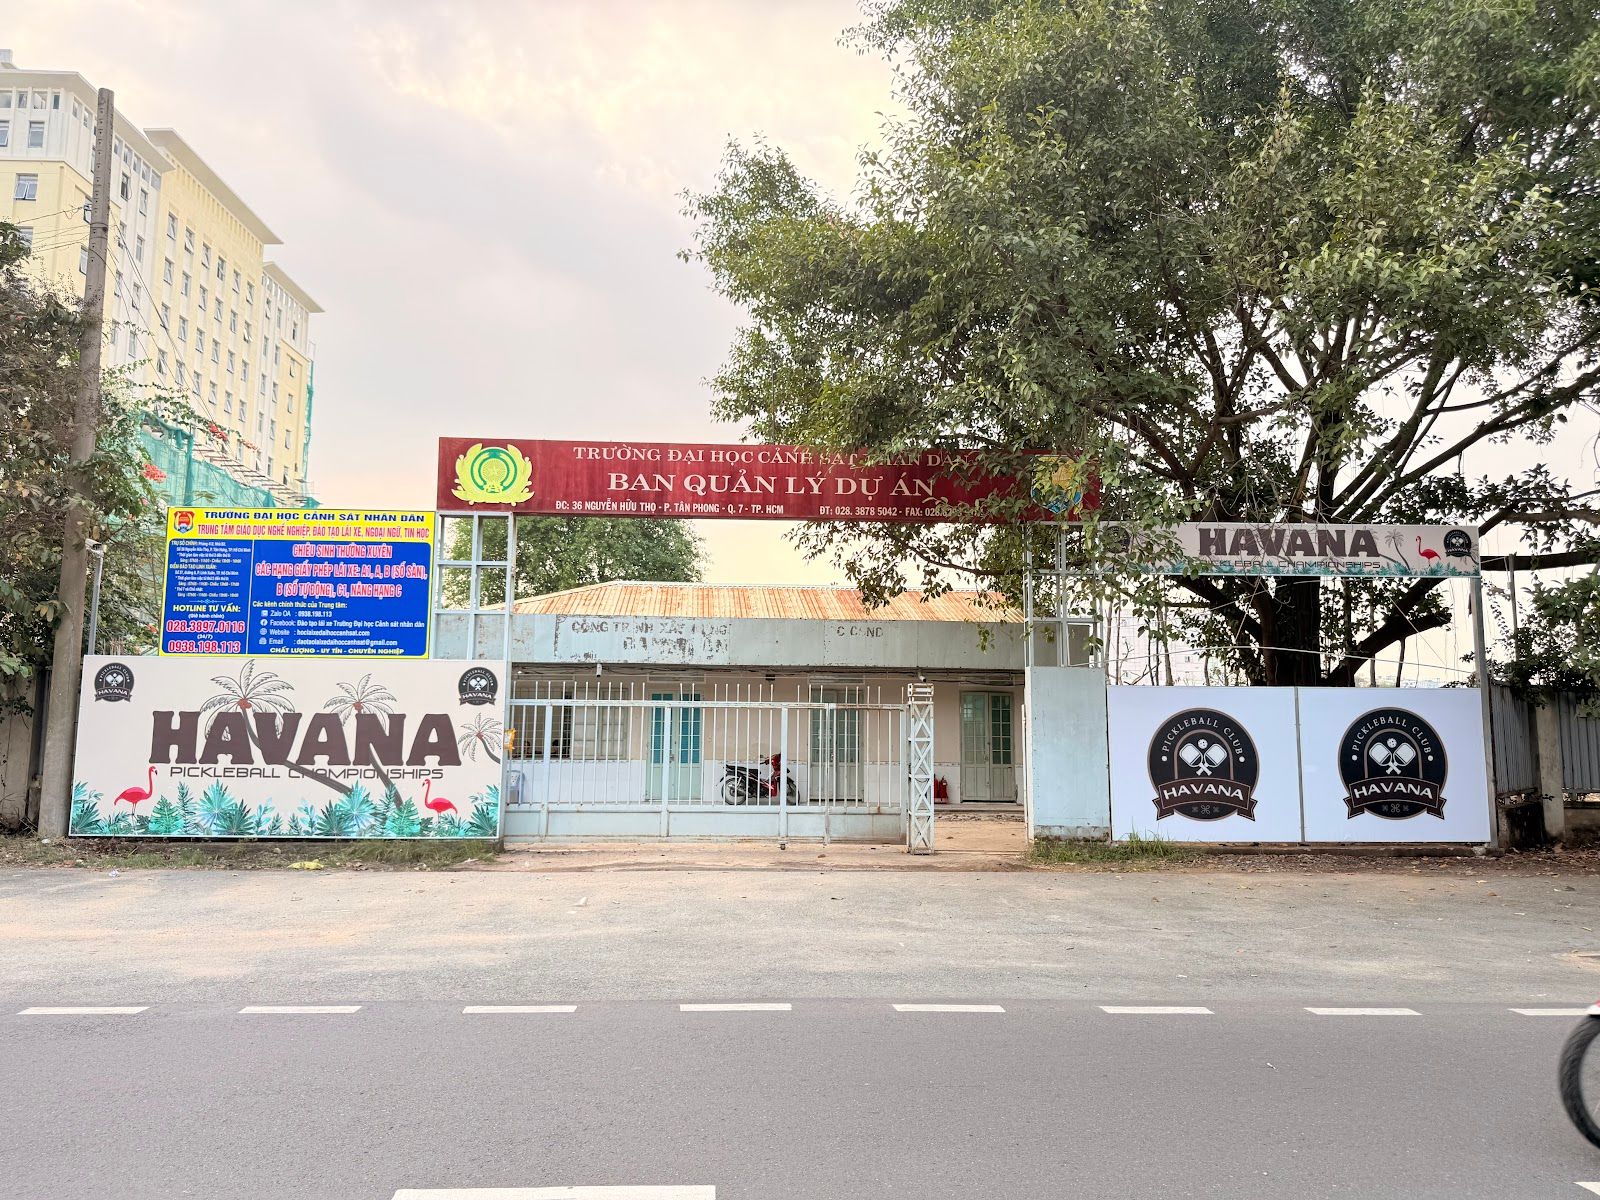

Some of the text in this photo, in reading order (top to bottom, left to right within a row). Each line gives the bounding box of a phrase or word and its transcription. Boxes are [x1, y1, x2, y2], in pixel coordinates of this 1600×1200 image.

[573, 443, 661, 461] TRƯỜNG
[667, 449, 704, 465] ĐẠI
[710, 450, 754, 466] HỌC
[757, 447, 814, 465] CẢNH
[607, 468, 934, 501] BAN QUẢN LÝ DỰ ÁN
[555, 500, 570, 510] ĐC:
[572, 500, 583, 510] 36
[584, 497, 618, 511] NGUYỄN
[620, 498, 637, 511] HỮU
[639, 502, 657, 514] THỌ
[663, 502, 672, 512] P.
[673, 501, 691, 513] TÂN
[692, 503, 720, 513] PHONG
[727, 504, 736, 515] Q.
[738, 504, 744, 514] 7
[751, 504, 764, 514] TP.
[765, 504, 784, 514] HCM
[819, 505, 833, 515] ĐT:
[835, 506, 853, 516] 028.
[854, 506, 875, 516] 3878
[877, 506, 898, 516] 5042
[905, 507, 923, 517] FAX:
[204, 510, 425, 522] TRƯỜNG ĐẠI HỌC CẢNH SÁT NHÂN DÂN
[197, 524, 219, 535] TRUNG
[220, 522, 235, 535] TÂM
[235, 522, 251, 536] GIÁO
[252, 524, 266, 537] DỤC
[312, 524, 326, 537] ĐÀO
[327, 526, 340, 538] TẠO
[341, 524, 352, 537] LÁI
[365, 527, 385, 540] NGOẠI
[404, 527, 415, 538] TIN
[416, 528, 430, 540] HỌC
[292, 542, 393, 558] CHIÊU SINH THƯỜNG XUYÊN
[1198, 528, 1380, 557] HAVANA
[255, 560, 272, 576] CÁC
[271, 562, 293, 579] HẠNG
[294, 559, 313, 577] GIẤY
[312, 561, 333, 577] PHÉP
[333, 561, 347, 577] LÁI
[374, 564, 384, 579] A,
[383, 564, 391, 578] B
[276, 582, 283, 596] B
[350, 581, 372, 597] NÂNG
[372, 583, 396, 600] HẠNG
[395, 584, 402, 598] C
[172, 602, 241, 613] HOTLINE TƯ VẤN:
[252, 600, 264, 608] Các
[263, 600, 278, 608] kênh
[278, 600, 294, 608] chính
[294, 600, 307, 608] thức
[318, 601, 335, 609] Trung
[166, 620, 246, 633] 028.3897.0116
[168, 640, 241, 653] 0938.198.113
[378, 647, 405, 655] NGHIỆP
[98, 688, 128, 696] HAVANA
[149, 711, 462, 766] HAVANA
[1161, 717, 1243, 755] PICKLEBALL CLUB
[1351, 716, 1432, 754] PICKLEBALL CLUB
[169, 766, 281, 778] PICKLEBALL
[1163, 783, 1244, 800] HAVANA
[1353, 782, 1433, 799] HAVANA
